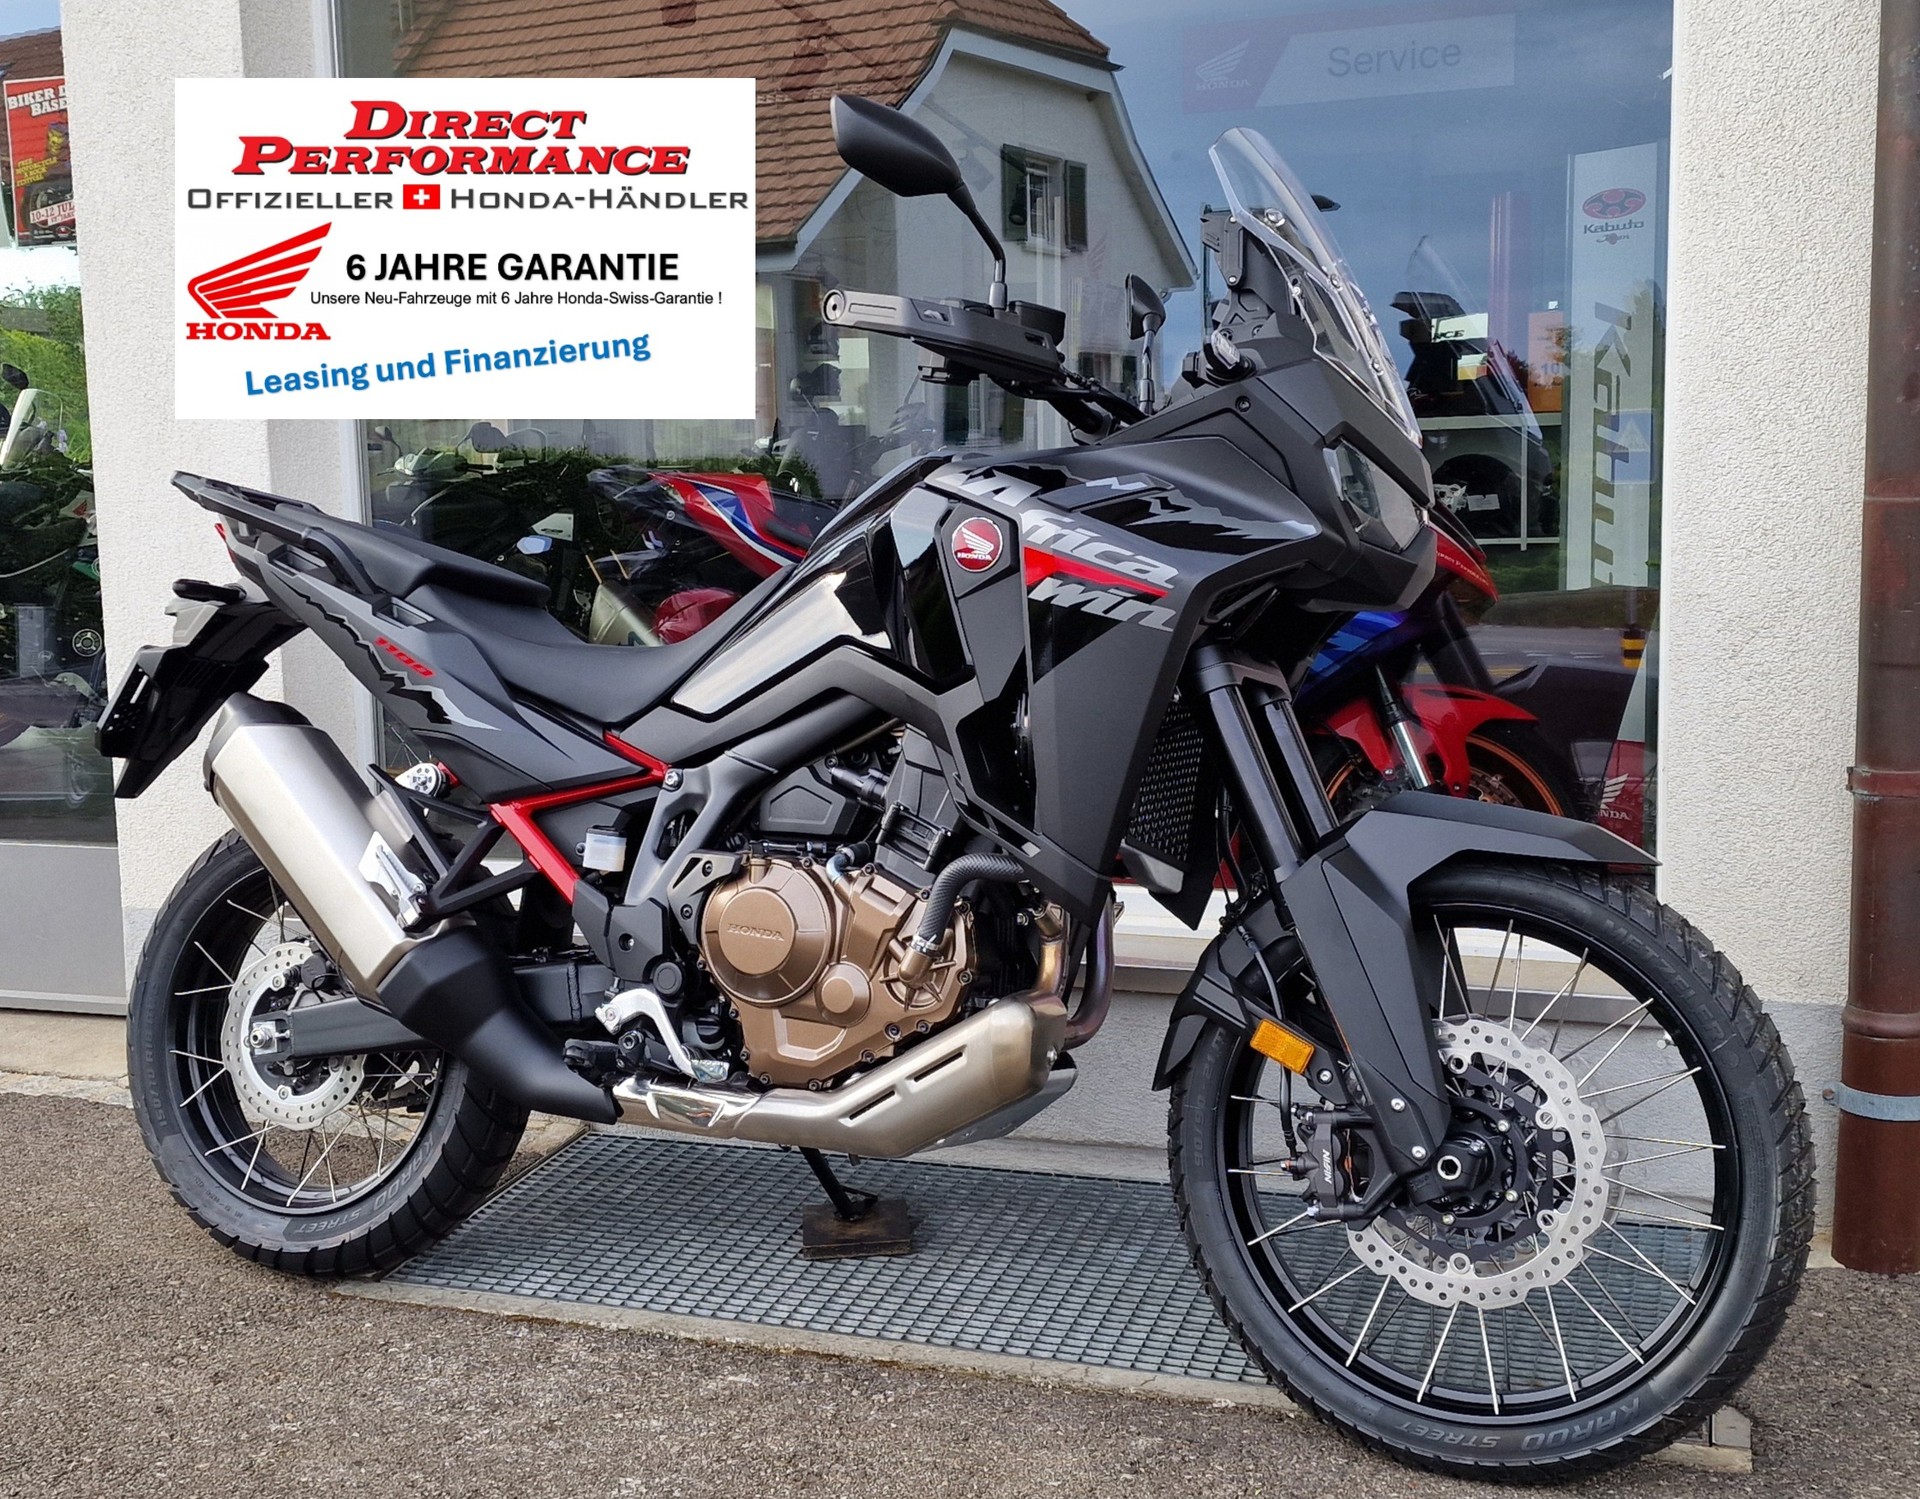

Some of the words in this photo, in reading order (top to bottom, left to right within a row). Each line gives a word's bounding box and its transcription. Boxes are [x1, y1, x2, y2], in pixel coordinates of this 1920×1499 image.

[1326, 40, 1461, 77] Service
[7, 86, 55, 109] BIKER
[31, 206, 54, 221] 10-12
[1583, 219, 1645, 234] Kabuto
[956, 551, 994, 562] HONDA
[374, 635, 436, 678] 1100
[727, 923, 785, 942] HONDA
[373, 1133, 434, 1211] KAROO
[295, 1209, 362, 1235] STREET
[1396, 1420, 1501, 1449] STREET
[1521, 1397, 1641, 1451] KAROO
